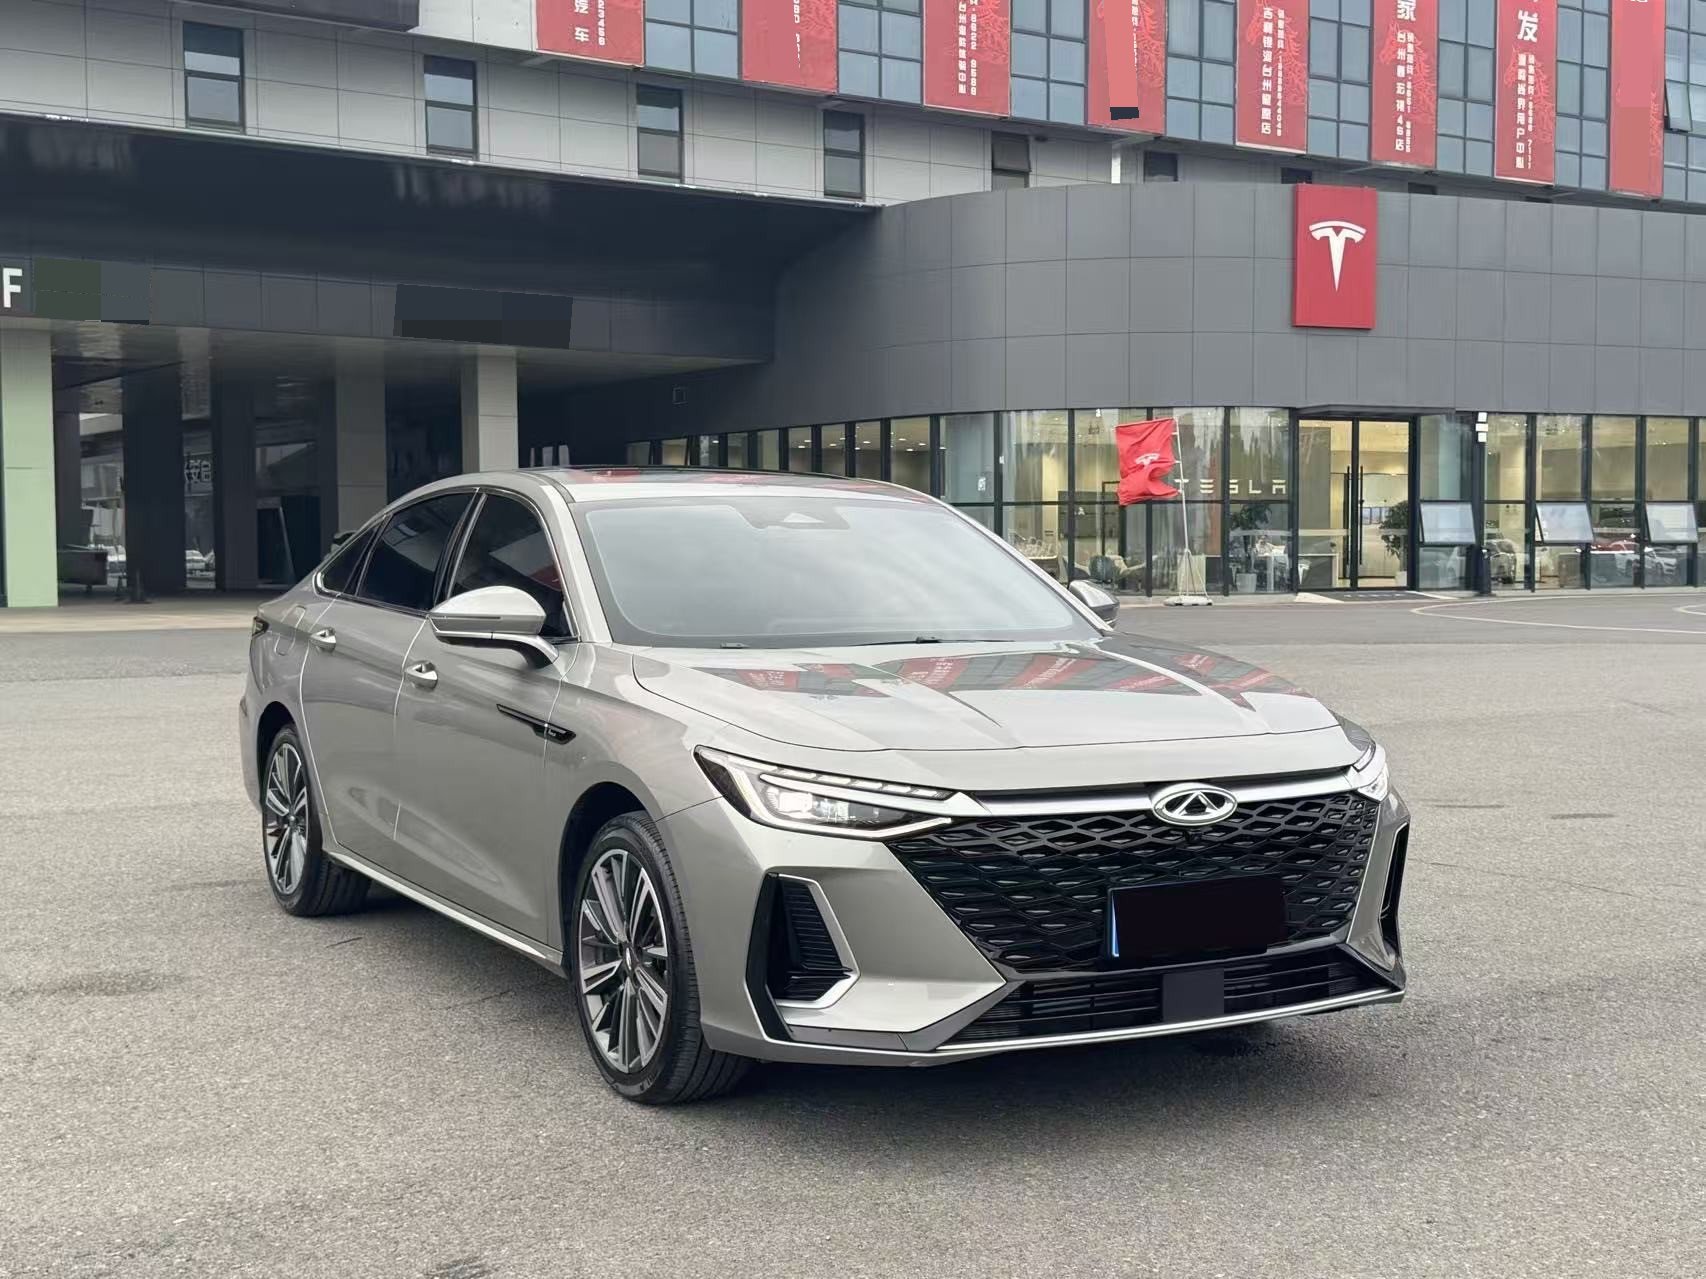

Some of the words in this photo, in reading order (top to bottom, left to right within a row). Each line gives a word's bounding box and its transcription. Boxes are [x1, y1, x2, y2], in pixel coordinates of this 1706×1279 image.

[1396, 0, 1417, 22] 家
[1517, 9, 1540, 43] 发
[2, 267, 23, 309] F
[1173, 479, 1288, 495] TESLA
